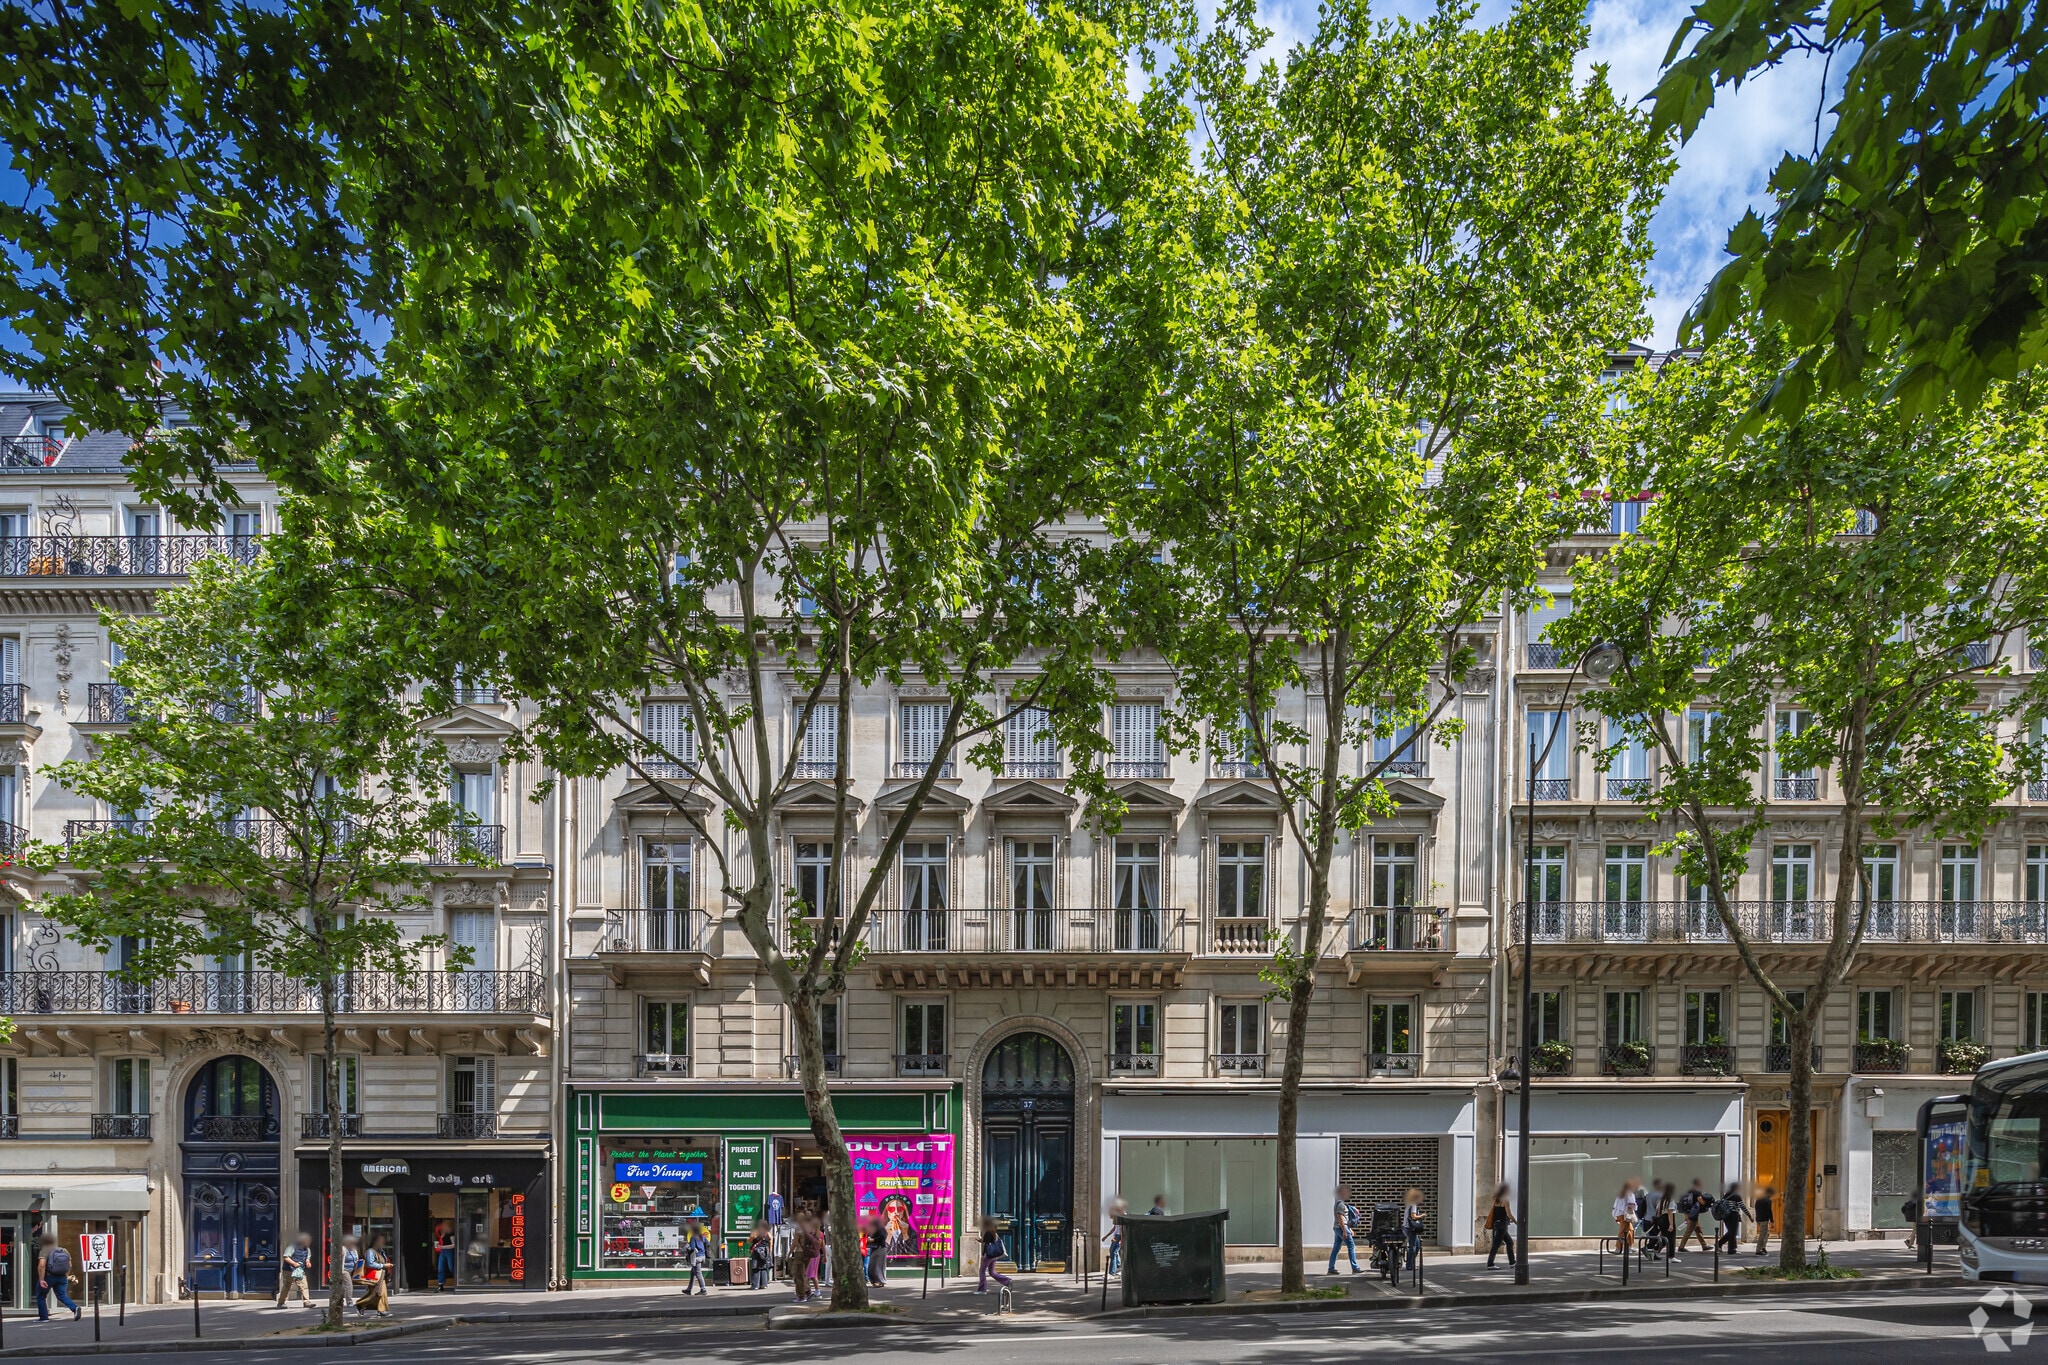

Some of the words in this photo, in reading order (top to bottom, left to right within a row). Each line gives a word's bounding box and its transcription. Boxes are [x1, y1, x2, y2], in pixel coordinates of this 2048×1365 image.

[845, 1141, 950, 1152] OUTLET
[610, 1150, 635, 1158] Protect
[653, 1150, 677, 1158] Planet
[363, 1165, 408, 1173] AMERICAN
[853, 1158, 883, 1171] Five
[886, 1157, 937, 1174] Vintage
[626, 1164, 650, 1177] Five
[651, 1164, 693, 1180] Vintage
[511, 1194, 525, 1280] PIERCING
[88, 1262, 110, 1270] KFC
